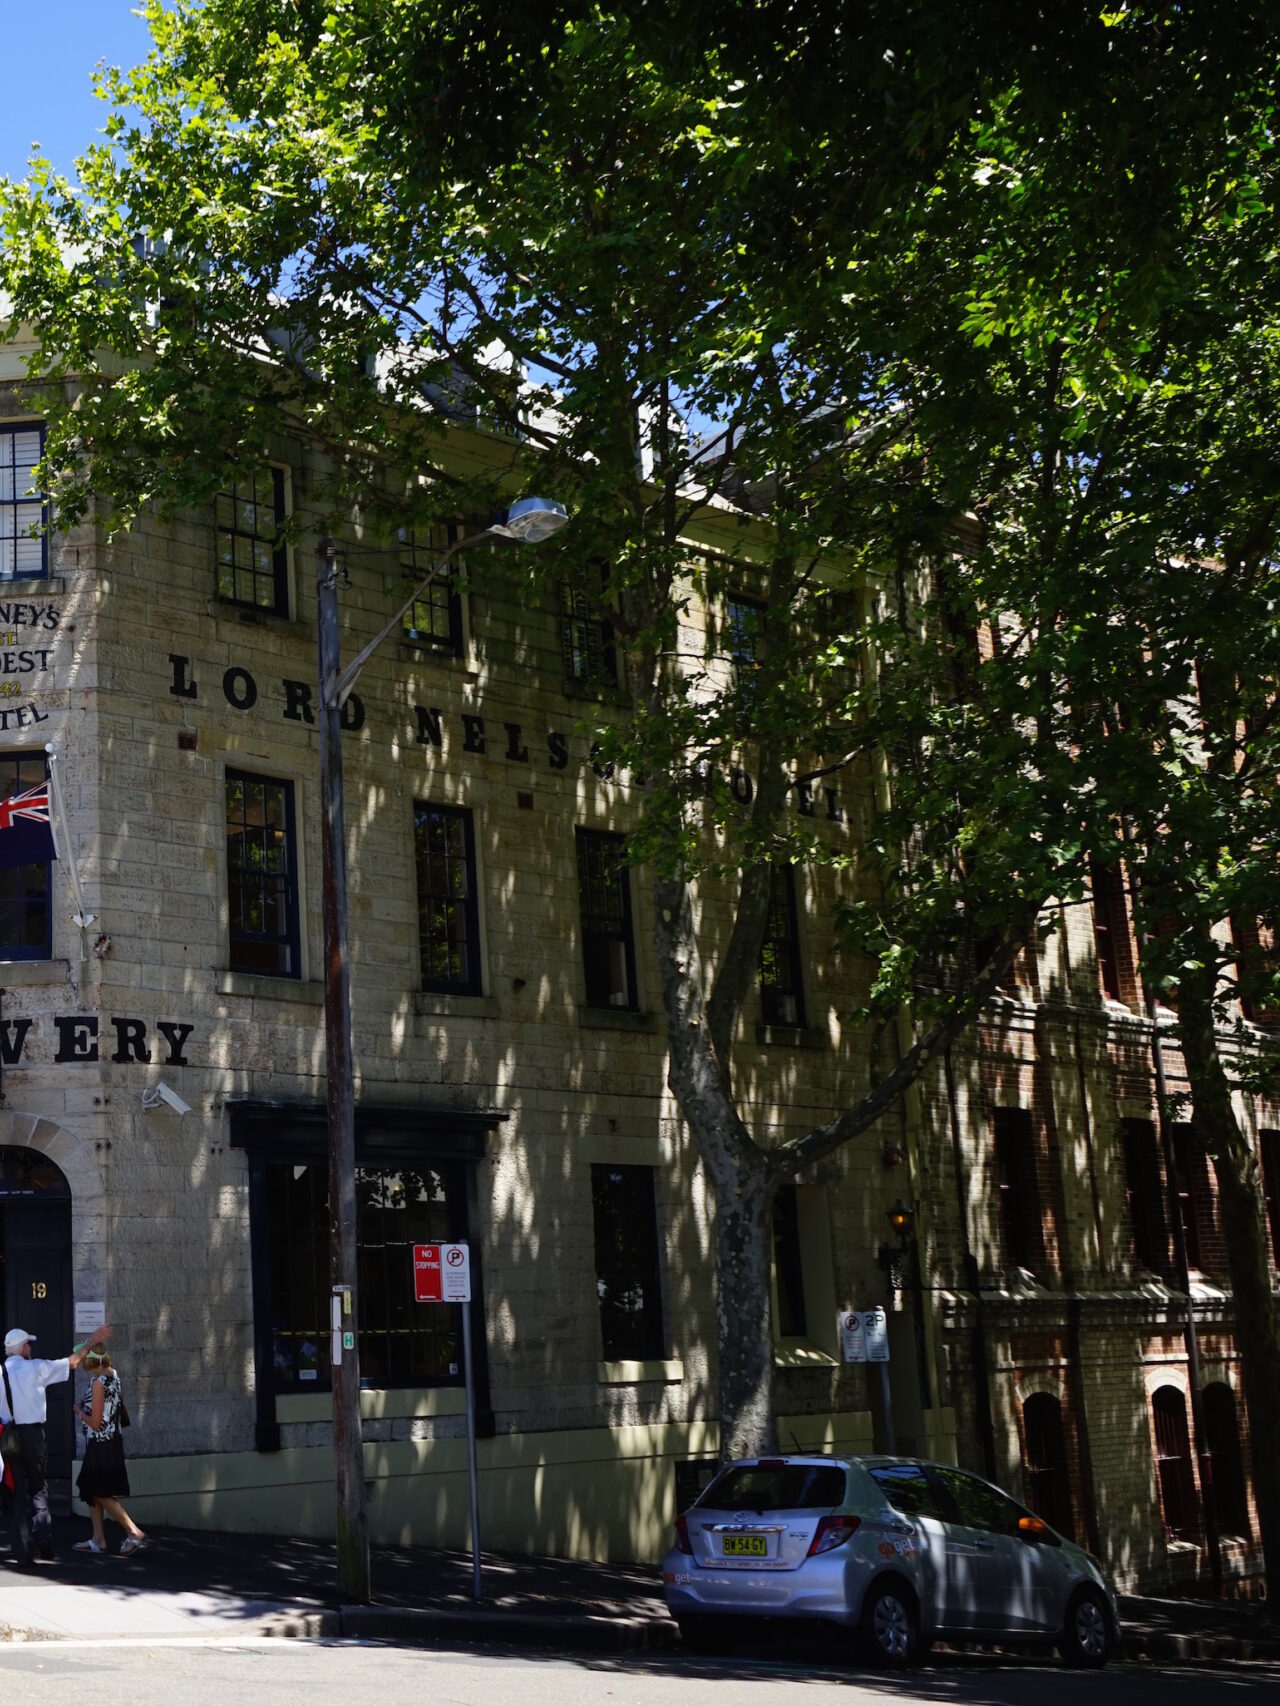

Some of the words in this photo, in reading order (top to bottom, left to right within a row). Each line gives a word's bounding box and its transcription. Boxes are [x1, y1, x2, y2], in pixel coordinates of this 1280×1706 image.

[169, 654, 366, 732] LORD
[415, 704, 646, 787] NELSO
[421, 1250, 432, 1258] NO
[415, 1261, 440, 1269] STOPPING
[31, 1282, 47, 1299] 19
[865, 1314, 883, 1327] 2P
[344, 1335, 353, 1346] H
